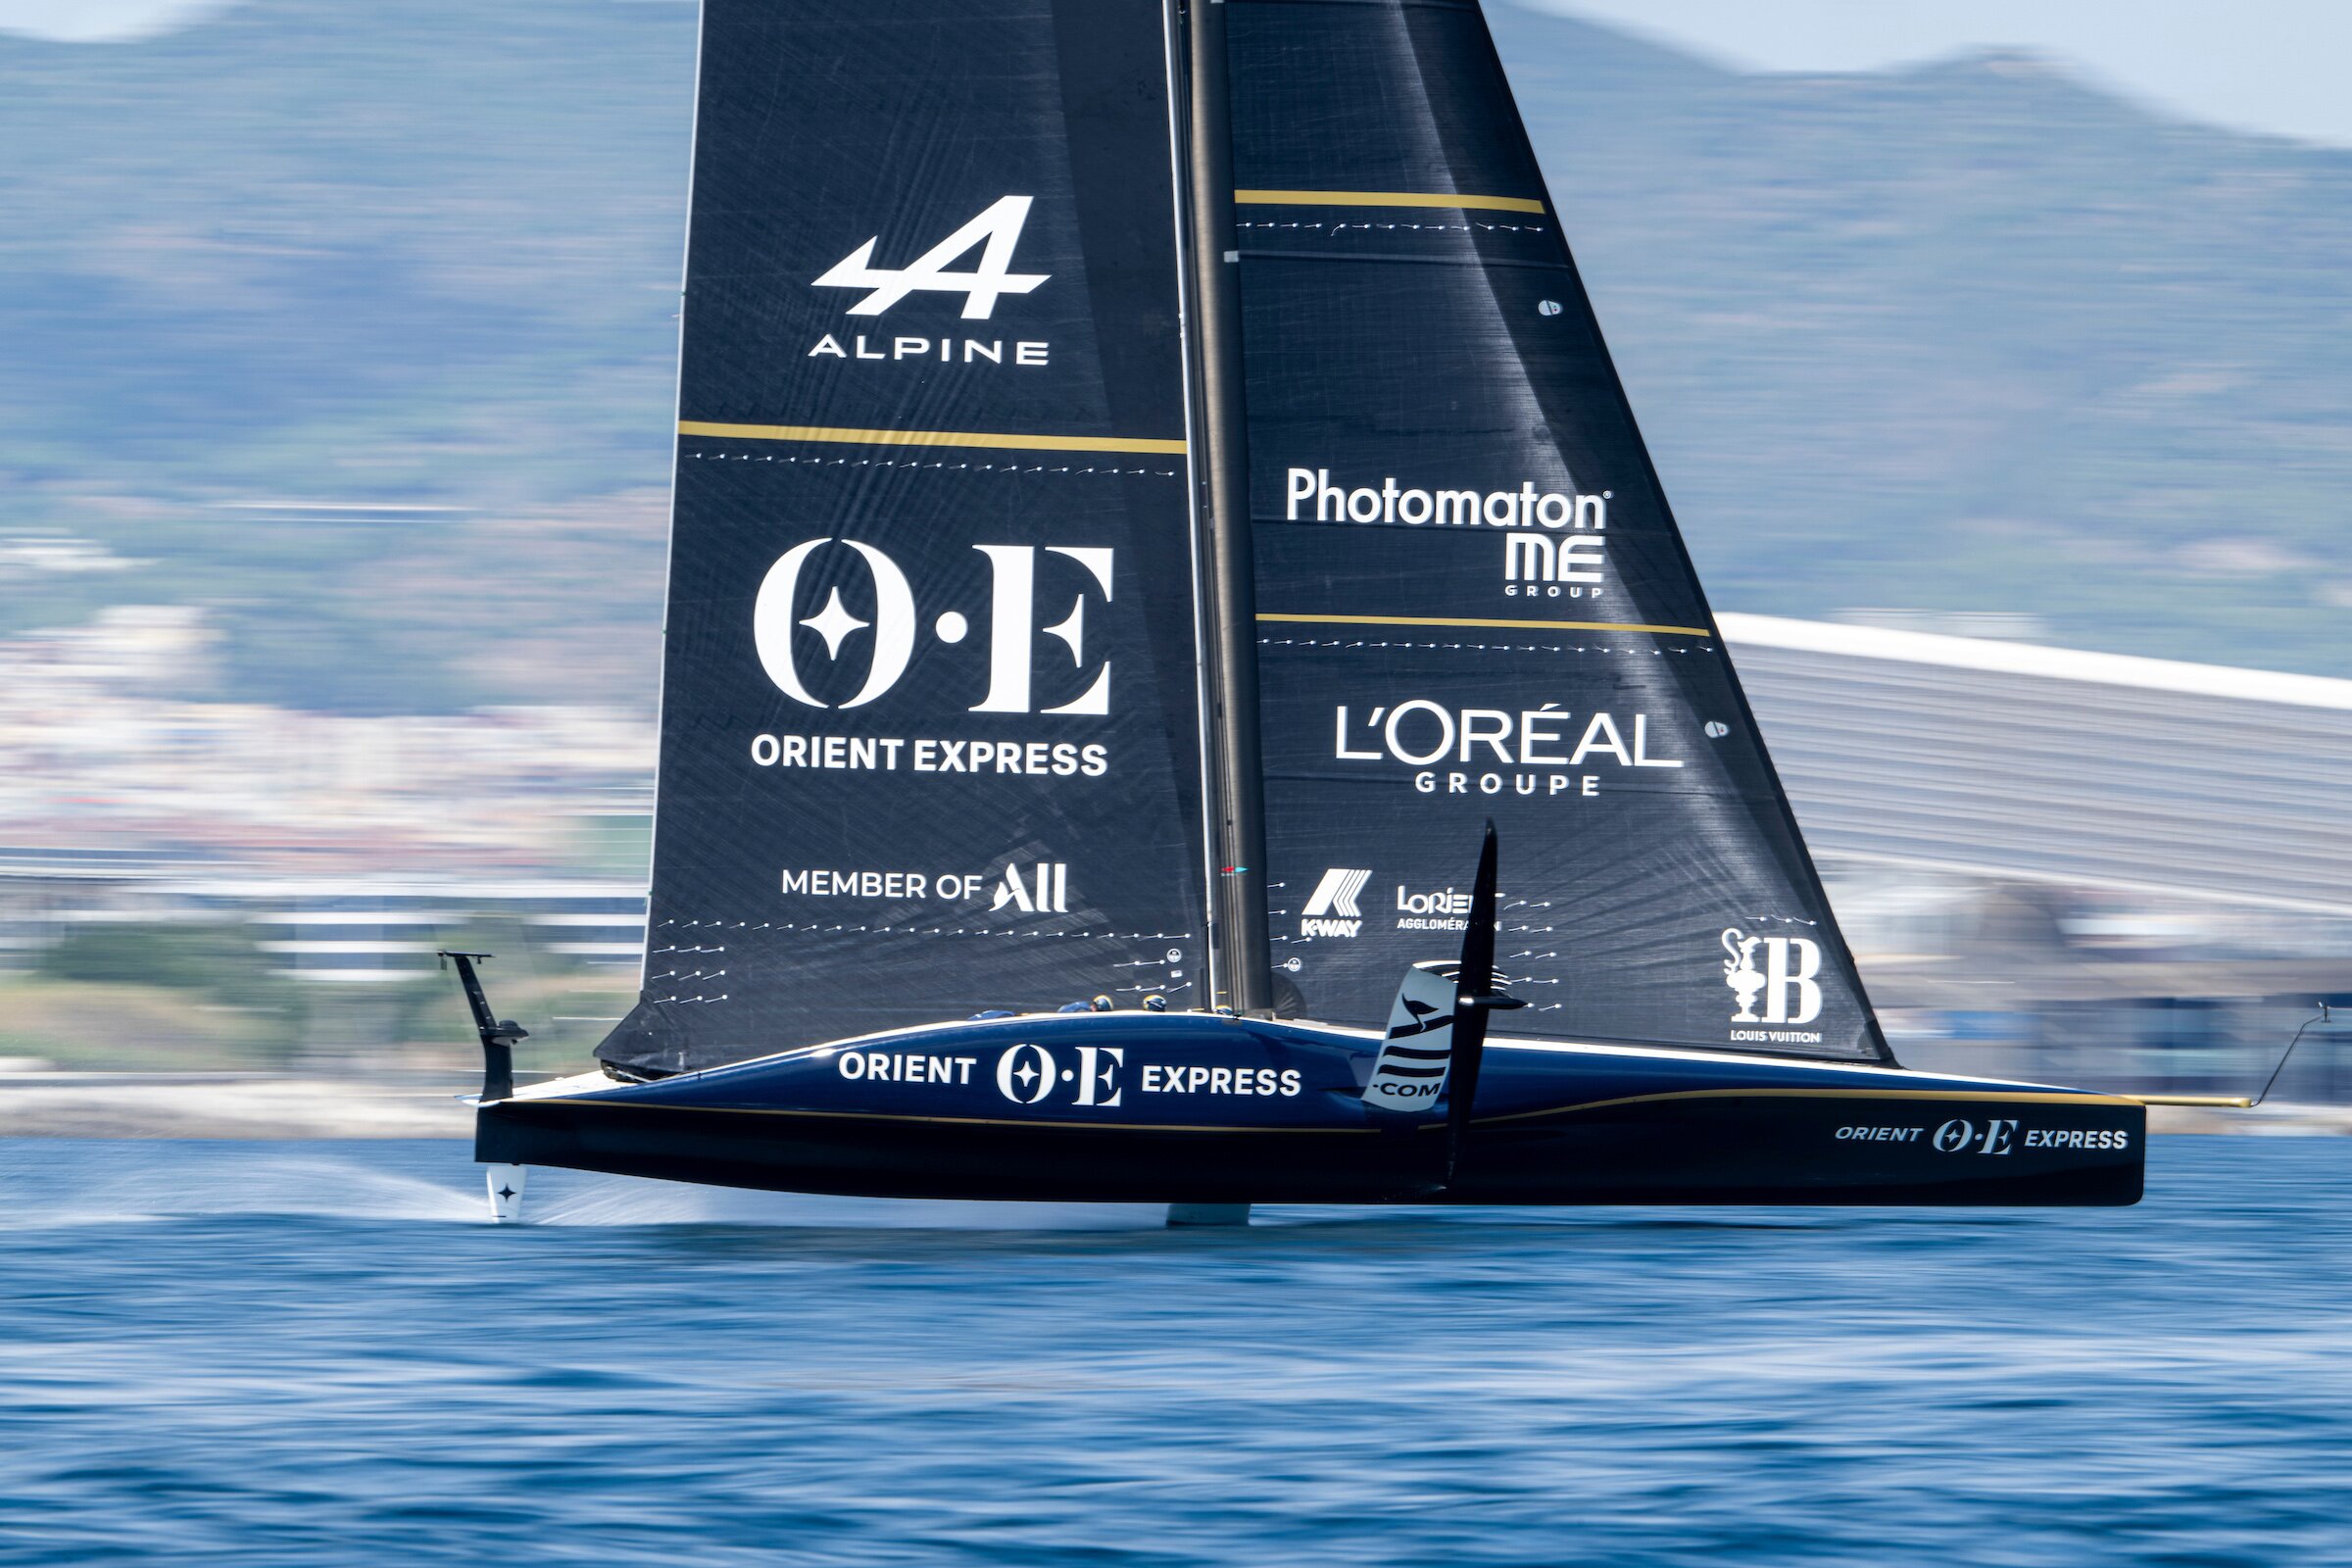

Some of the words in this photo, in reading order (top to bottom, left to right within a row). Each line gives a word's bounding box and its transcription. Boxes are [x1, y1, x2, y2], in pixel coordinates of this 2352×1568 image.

[808, 334, 1049, 366] ALPINE
[1287, 467, 1606, 529] Photomaton
[1505, 585, 1602, 597] GROUP
[1336, 700, 1684, 767] L'ORÉAL
[752, 734, 904, 769] ORIENT
[914, 740, 1107, 776] EXPRESS
[1415, 772, 1599, 796] GROUPE
[783, 869, 926, 898] MEMBER
[936, 874, 983, 900] OF
[1730, 1029, 1766, 1042] LOUIS
[1767, 1031, 1822, 1043] VUITTON
[838, 1051, 977, 1085] ORIENT
[1142, 1065, 1300, 1096] EXPRESS
[1836, 1127, 1924, 1141] ORIENT
[2025, 1130, 2128, 1149] EXPRESS
